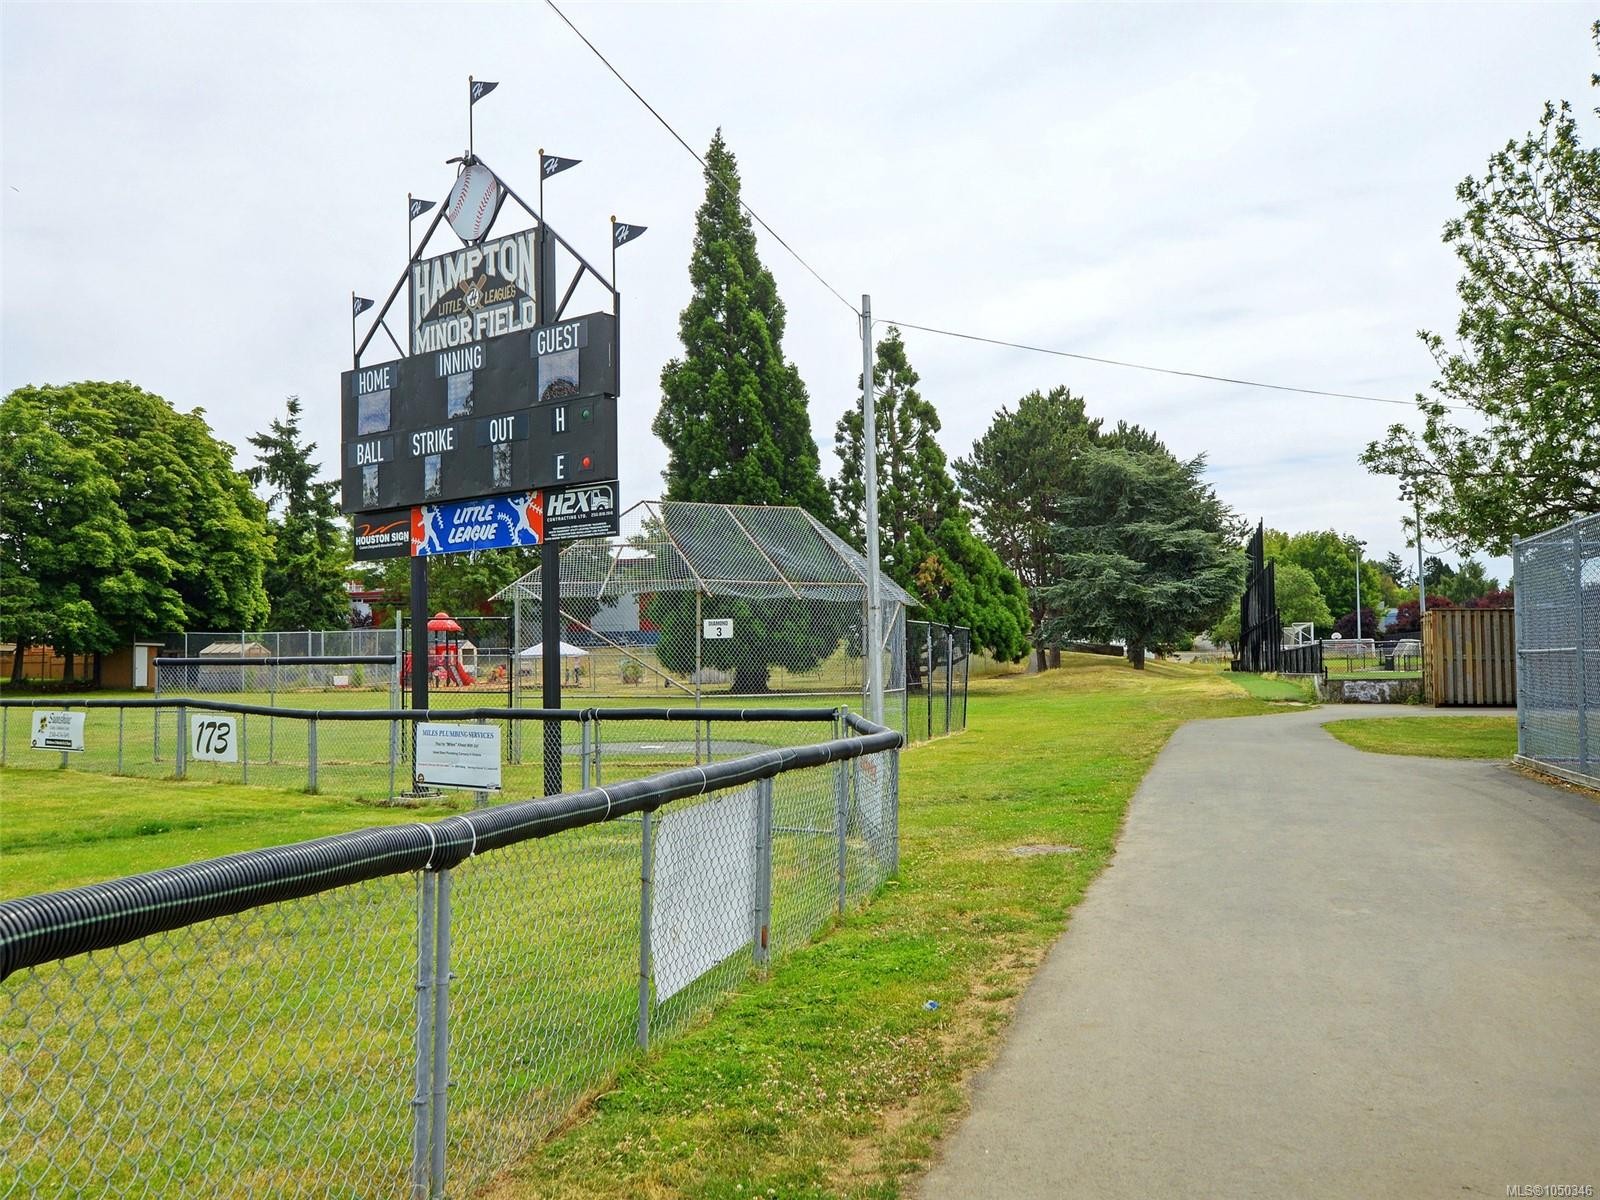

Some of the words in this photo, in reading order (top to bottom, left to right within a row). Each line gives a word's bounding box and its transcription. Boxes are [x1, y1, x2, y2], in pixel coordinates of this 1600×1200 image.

[543, 157, 558, 173] H
[615, 227, 629, 242] H
[413, 231, 536, 330] HAMPTON
[438, 298, 462, 316] LITTLE
[414, 316, 472, 355] MINOR
[474, 301, 536, 340] FIELD
[537, 323, 580, 355] GUEST
[439, 346, 482, 376] INNING
[359, 367, 390, 394] HOME
[489, 416, 515, 443] OUT
[555, 407, 565, 432] H
[357, 441, 384, 465] BALL
[412, 427, 454, 456] STRIKE
[556, 455, 565, 479] E
[453, 503, 495, 525] LITTLE
[547, 490, 592, 517] H2X
[546, 514, 577, 523] CONTRACTING
[355, 533, 390, 546] HOUSTON
[391, 531, 409, 542] SIGN
[448, 523, 498, 544] LEAGUE
[716, 627, 722, 636] 3
[196, 721, 230, 754] 173
[422, 729, 438, 737] MILES
[439, 730, 467, 738] PLUMBING
[468, 731, 494, 739] SERVICES
